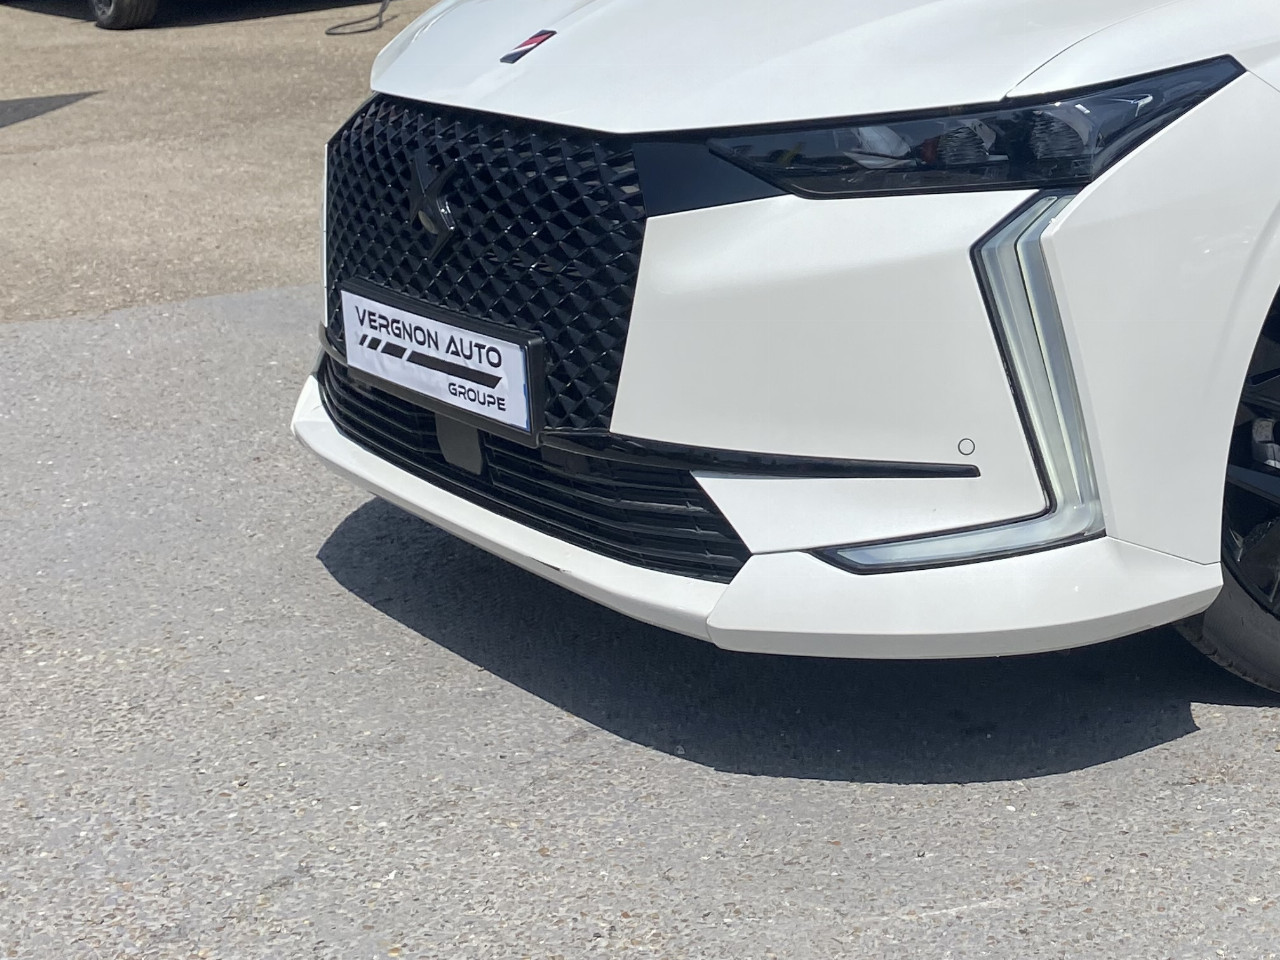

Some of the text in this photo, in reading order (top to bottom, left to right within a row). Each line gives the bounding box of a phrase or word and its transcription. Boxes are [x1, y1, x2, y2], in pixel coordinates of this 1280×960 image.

[355, 305, 503, 369] VERGNON AUTO
[447, 382, 506, 412] GROUPE
